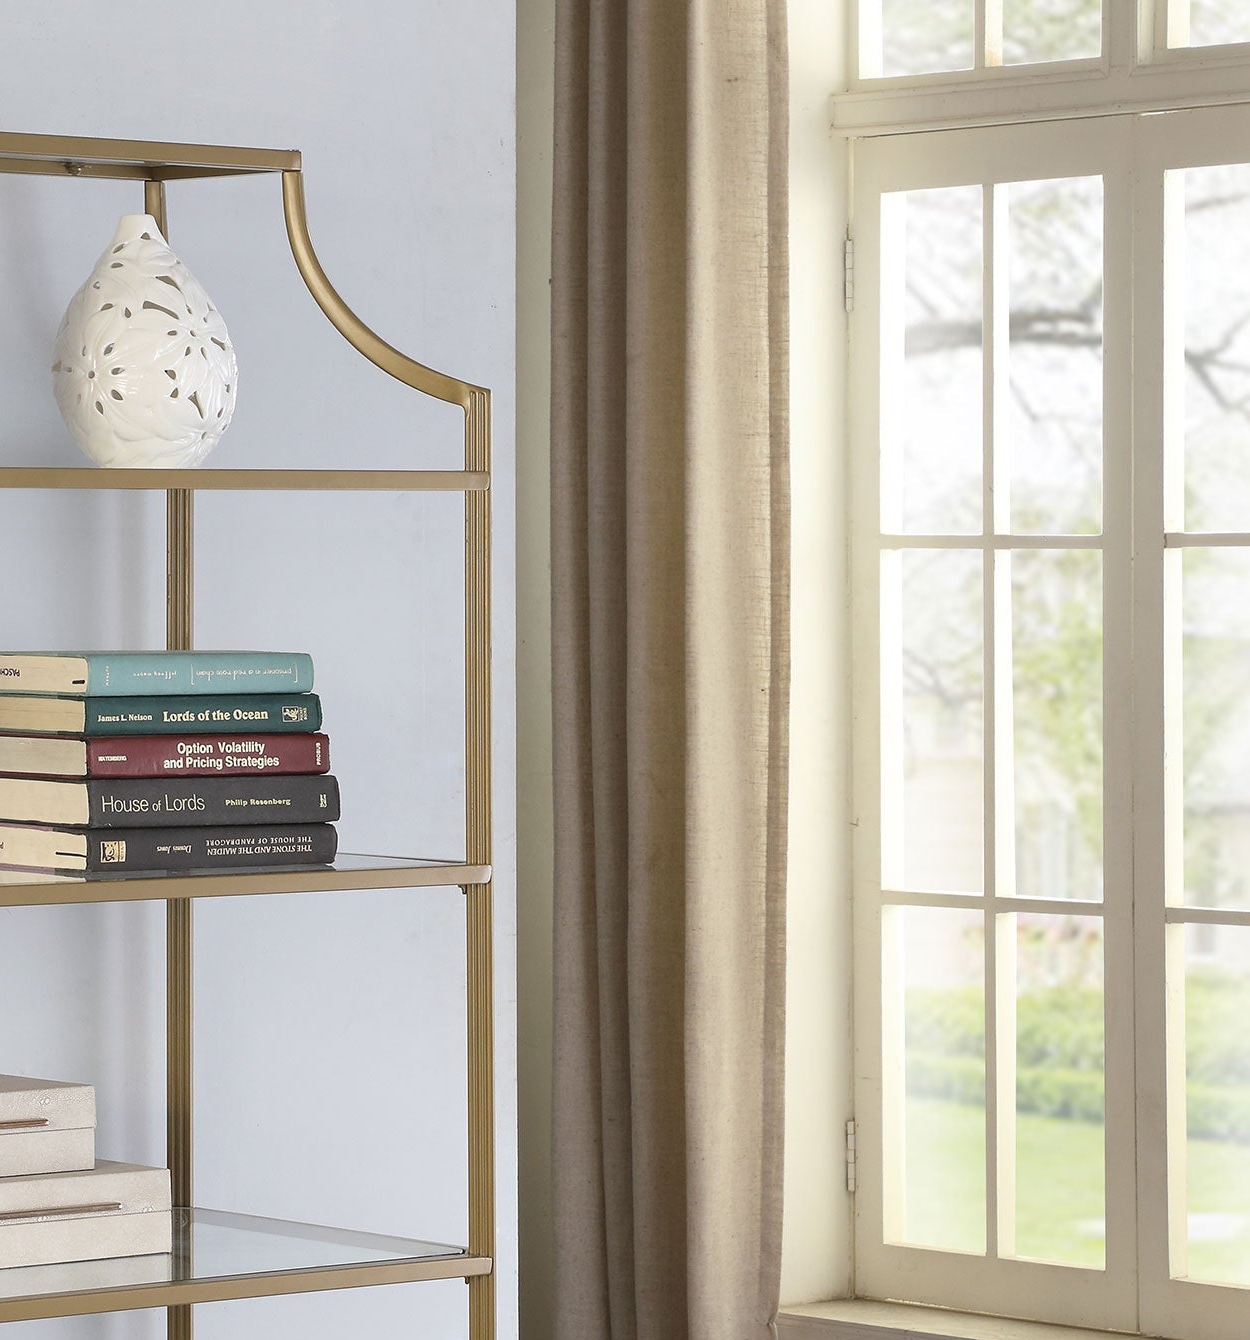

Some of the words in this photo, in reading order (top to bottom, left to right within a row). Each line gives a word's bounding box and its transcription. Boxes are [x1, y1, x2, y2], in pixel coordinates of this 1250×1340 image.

[196, 669, 215, 681] chain
[97, 714, 120, 722] James
[128, 713, 153, 721] Nelson
[163, 710, 195, 722] Lords
[197, 710, 210, 721] of
[211, 710, 231, 721] the
[233, 709, 269, 720] Ocean
[177, 742, 213, 757] Option
[218, 741, 265, 755] Volatility
[163, 757, 184, 769] and
[185, 756, 223, 770] Pricing
[225, 755, 280, 769] Strategies
[102, 795, 149, 813] House
[152, 801, 163, 812] of
[165, 794, 205, 811] Lords
[225, 798, 248, 807] Philip
[250, 797, 291, 806] Rosenberg
[207, 847, 238, 856] MAIDEN
[238, 846, 252, 854] THE
[253, 846, 271, 854] AND
[272, 845, 296, 854] STONE
[297, 844, 312, 852] THE
